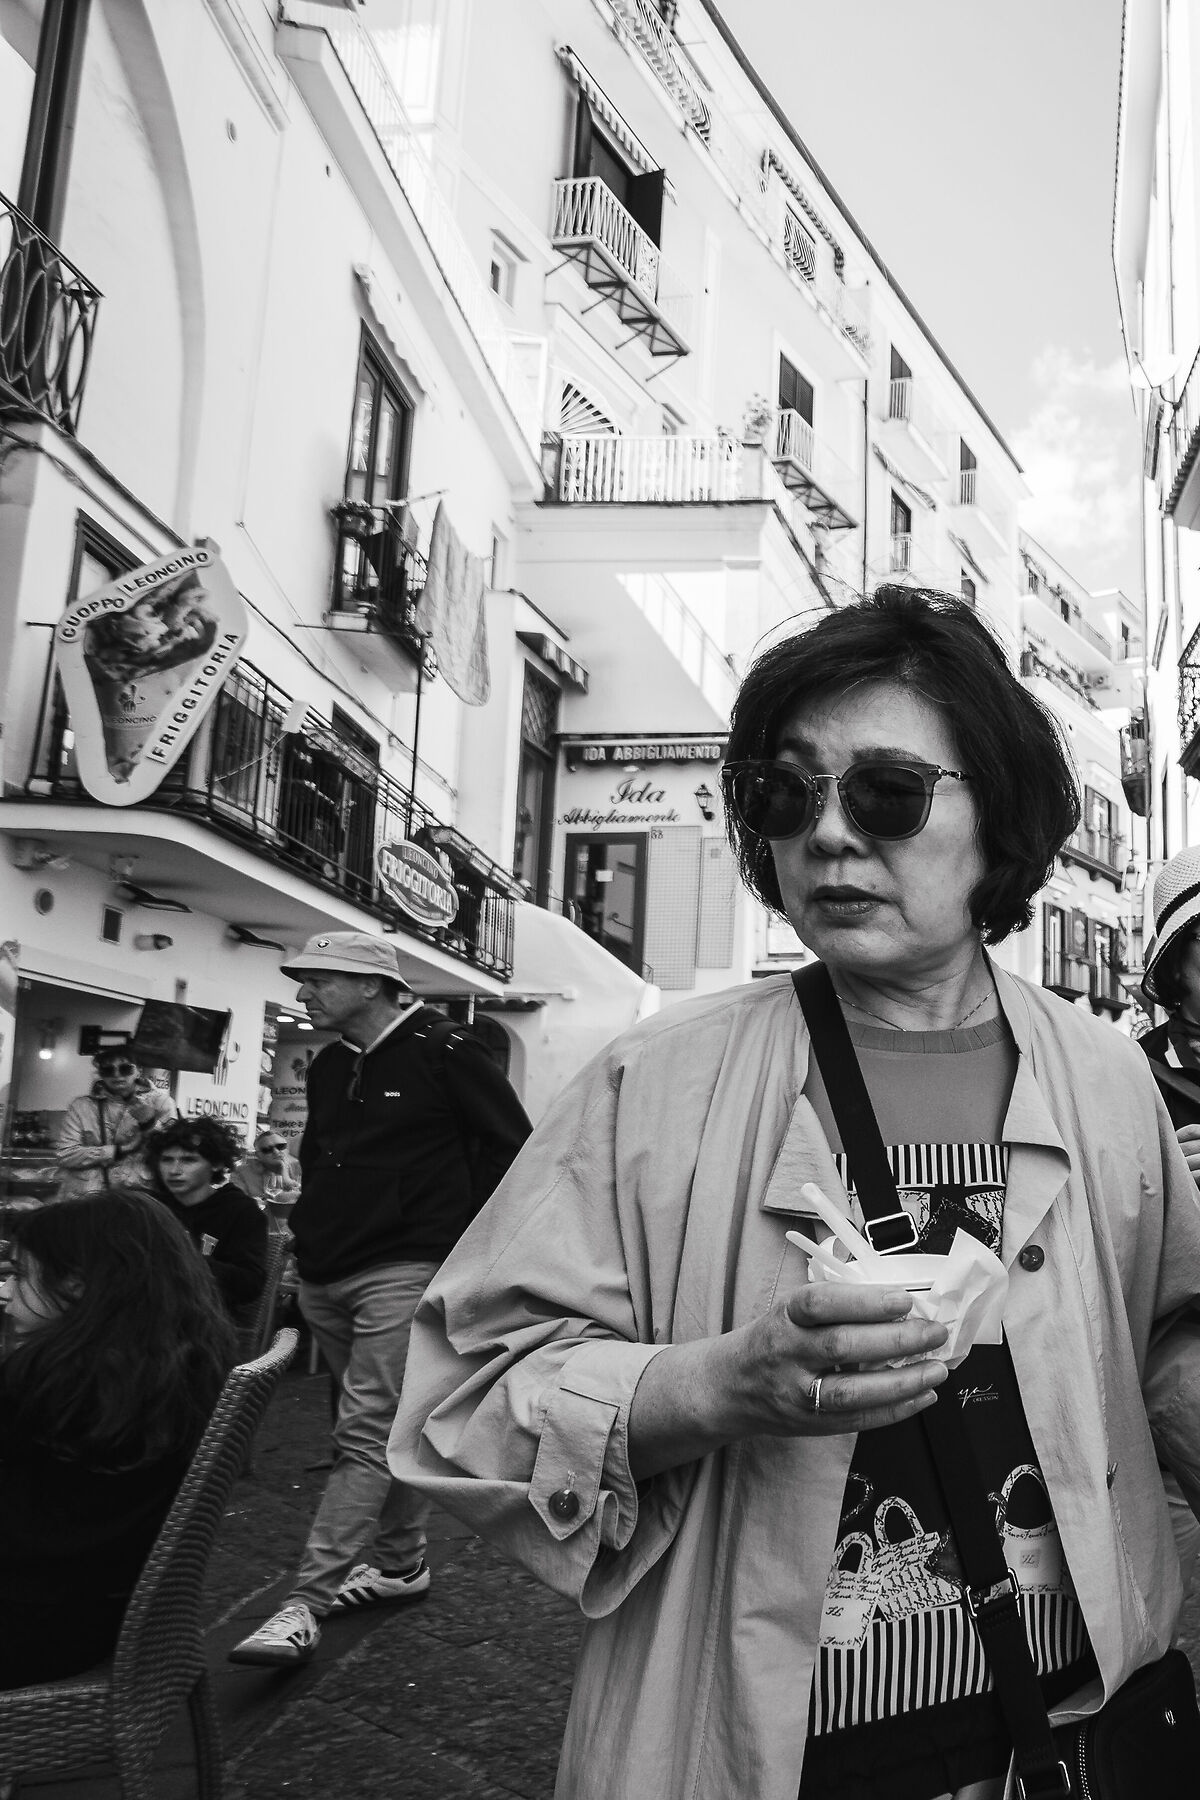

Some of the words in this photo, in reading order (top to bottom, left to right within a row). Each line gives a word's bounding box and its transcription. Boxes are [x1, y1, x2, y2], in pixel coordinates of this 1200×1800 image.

[62, 598, 125, 638] CUOPPO
[124, 551, 209, 592] LEONCINO
[152, 632, 240, 759] FRIGGITORIA
[112, 715, 157, 724] EONCINO
[584, 745, 606, 761] IDA
[612, 745, 721, 761] ABBIGLIAMENTO
[610, 777, 667, 804] Ida
[382, 849, 453, 916] FRIGGITORIA
[275, 1087, 306, 1095] LEON
[187, 1098, 249, 1119] LEONCINO
